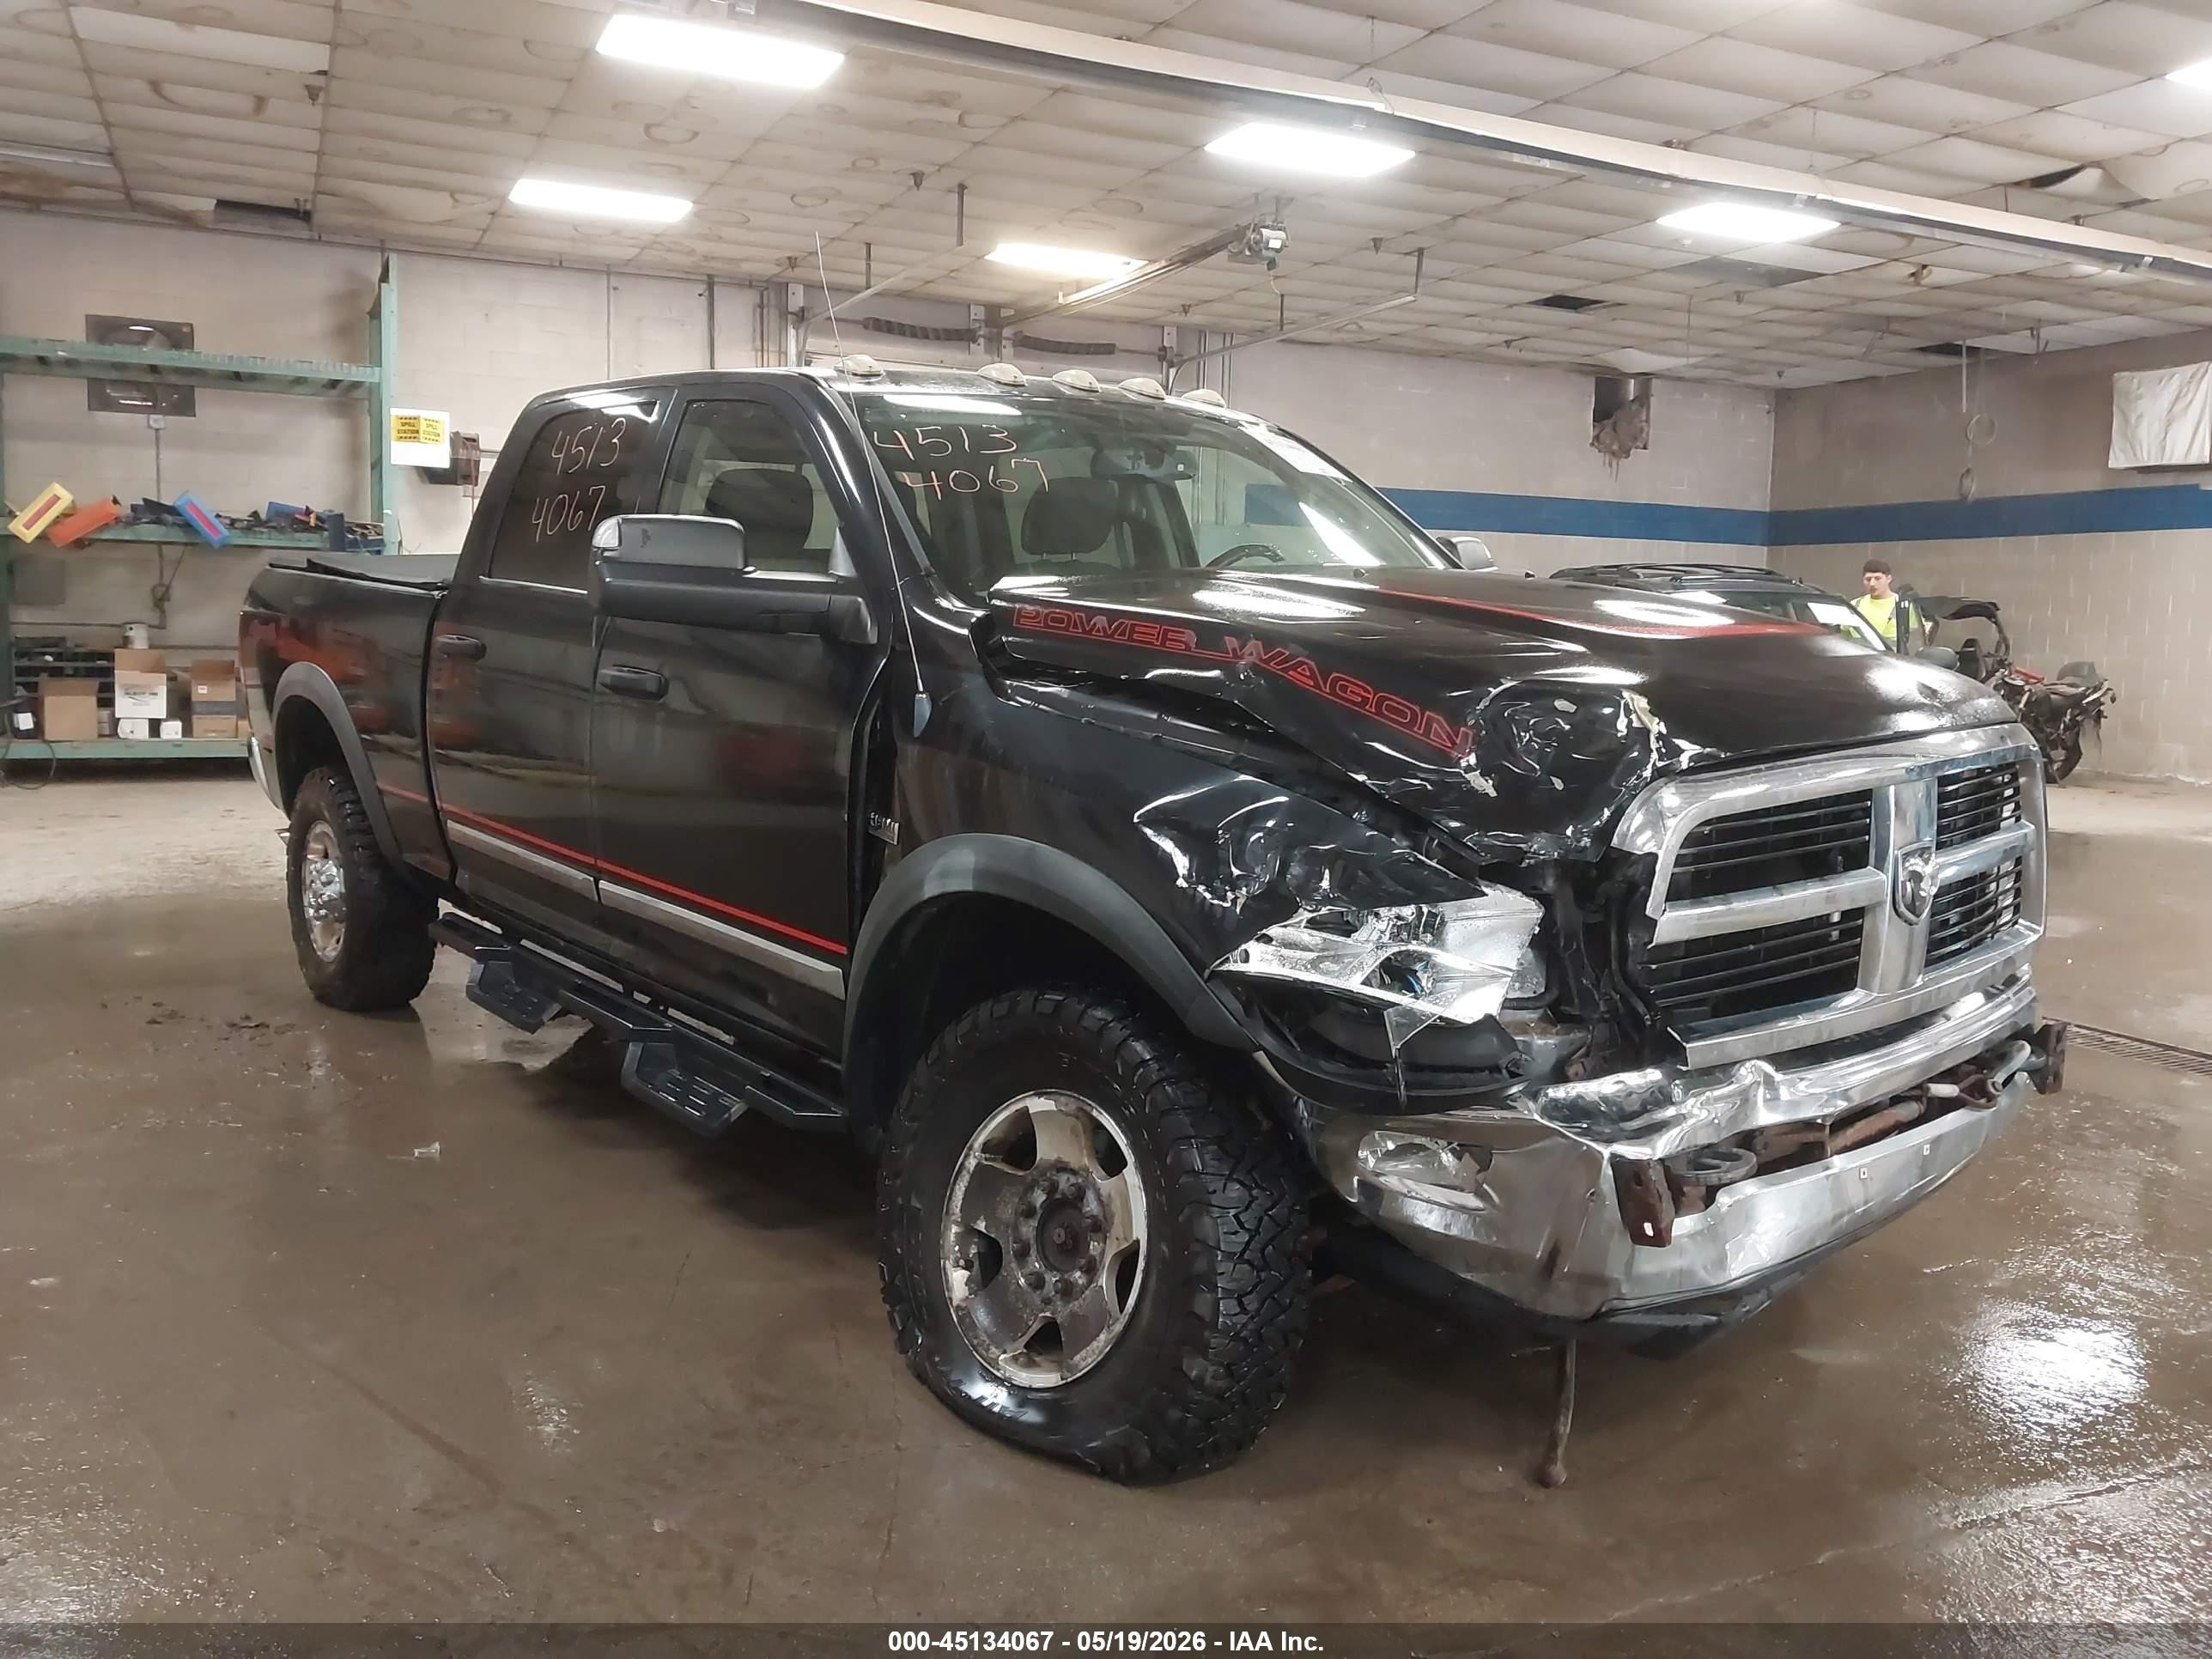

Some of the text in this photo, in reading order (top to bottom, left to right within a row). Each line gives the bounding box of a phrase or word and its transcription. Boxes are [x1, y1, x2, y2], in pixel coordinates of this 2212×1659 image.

[551, 417, 626, 475] 4513
[873, 424, 1018, 461] 4513
[902, 457, 1049, 501] 4067
[532, 485, 606, 543] 4067
[1012, 604, 1474, 759] POWER WAGON
